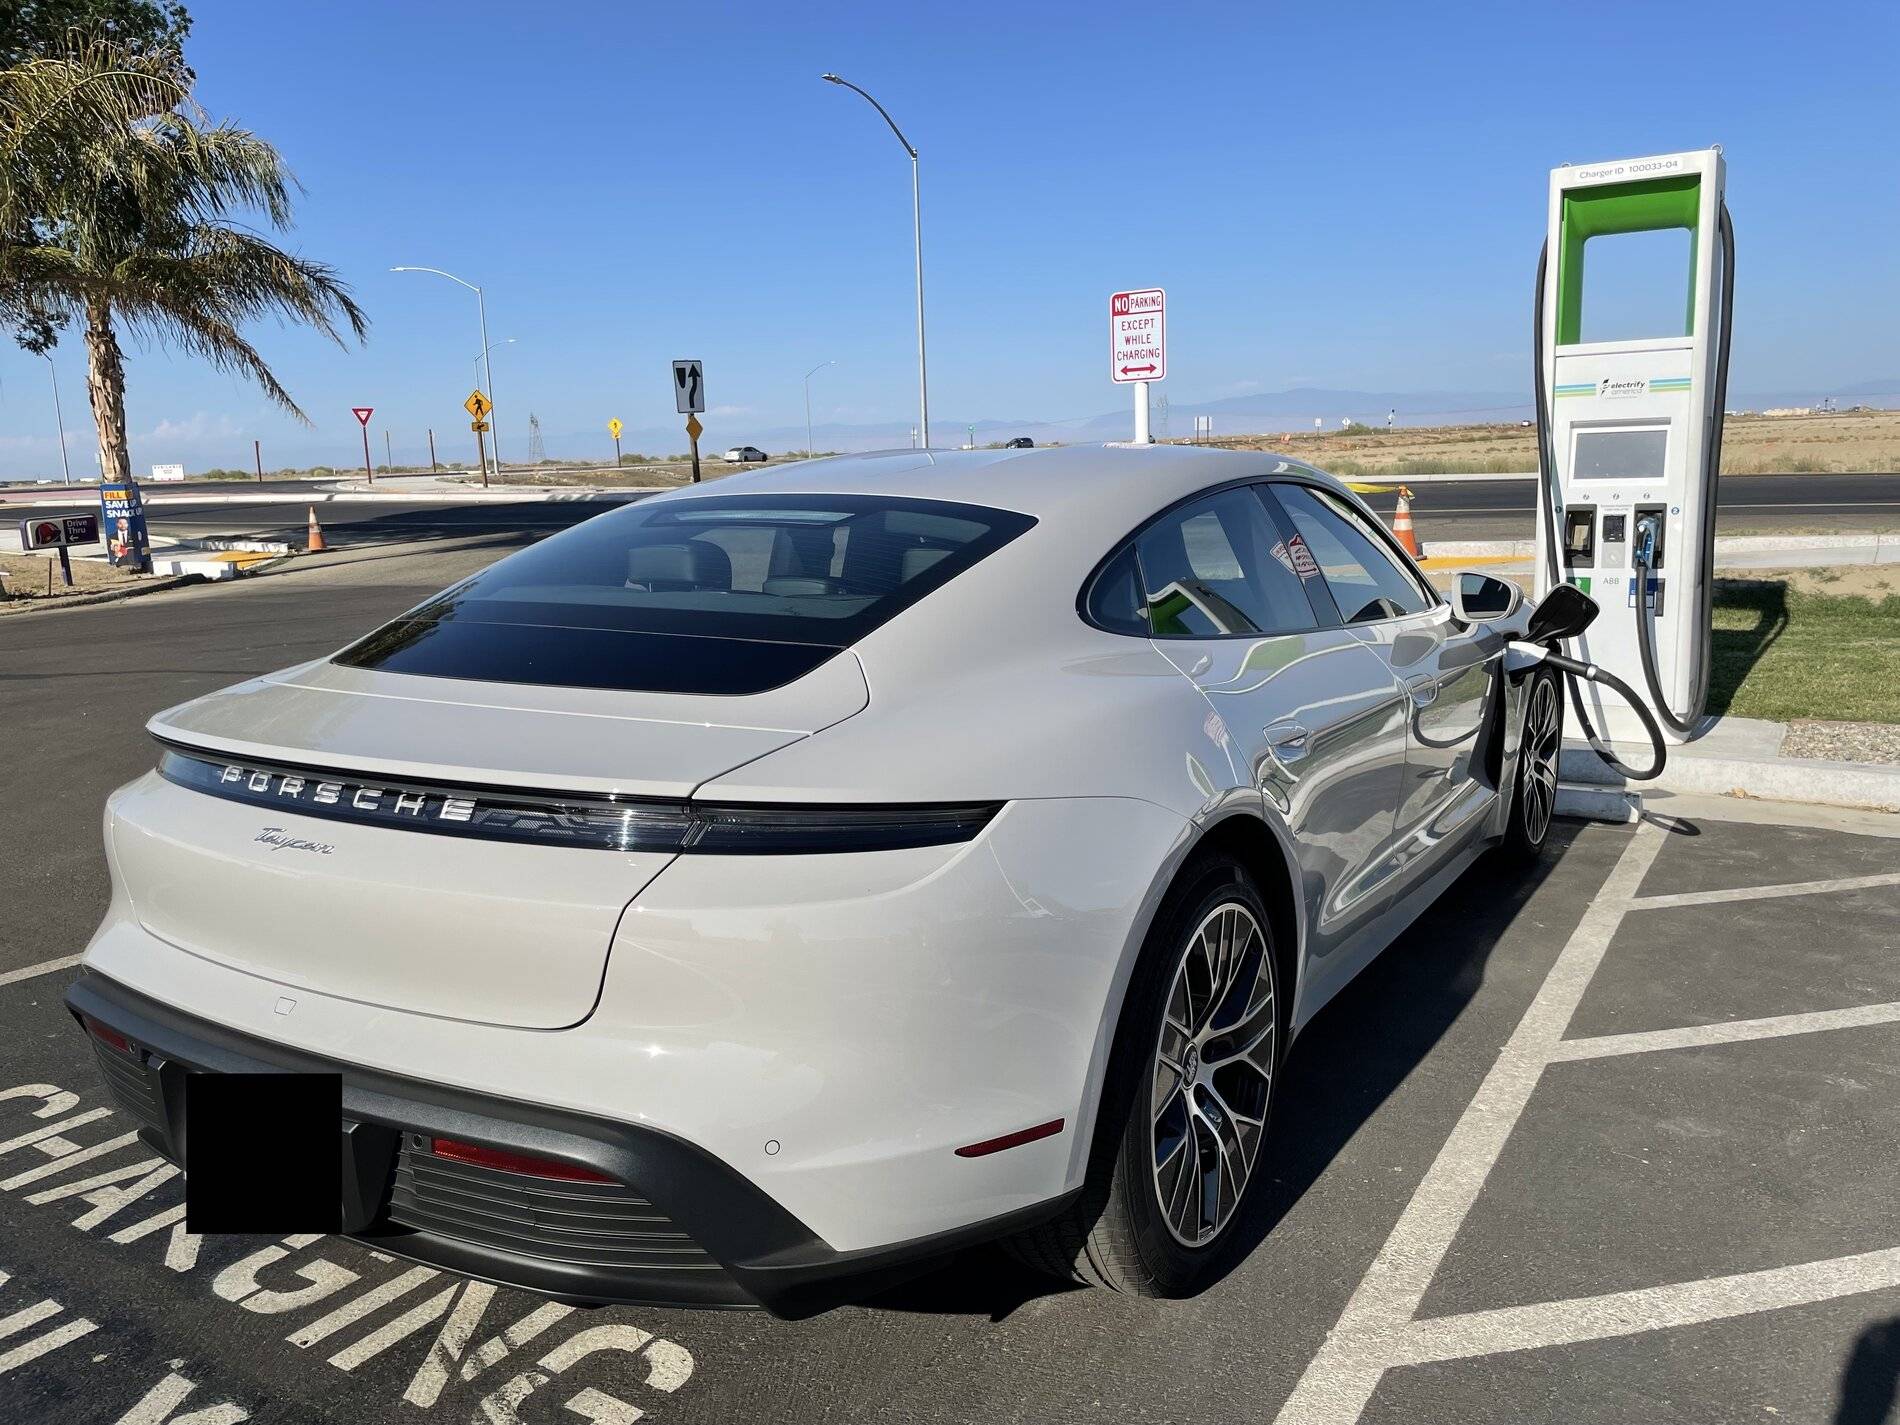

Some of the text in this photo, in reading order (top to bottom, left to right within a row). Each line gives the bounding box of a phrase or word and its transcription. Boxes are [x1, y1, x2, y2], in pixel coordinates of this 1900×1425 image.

[1579, 169, 1613, 179] Charger
[1629, 161, 1678, 173] 100033-04
[1115, 296, 1161, 312] NO PARKING
[1121, 319, 1155, 331] EXCEPT
[1125, 334, 1151, 345] WHILE
[1117, 348, 1160, 361] CHARGING
[1611, 380, 1646, 389] electrify
[104, 491, 122, 499] FILL
[105, 500, 129, 509] SAVE
[106, 509, 136, 518] SNACK
[221, 765, 478, 822] PORSCHE
[254, 826, 336, 855] Taycan
